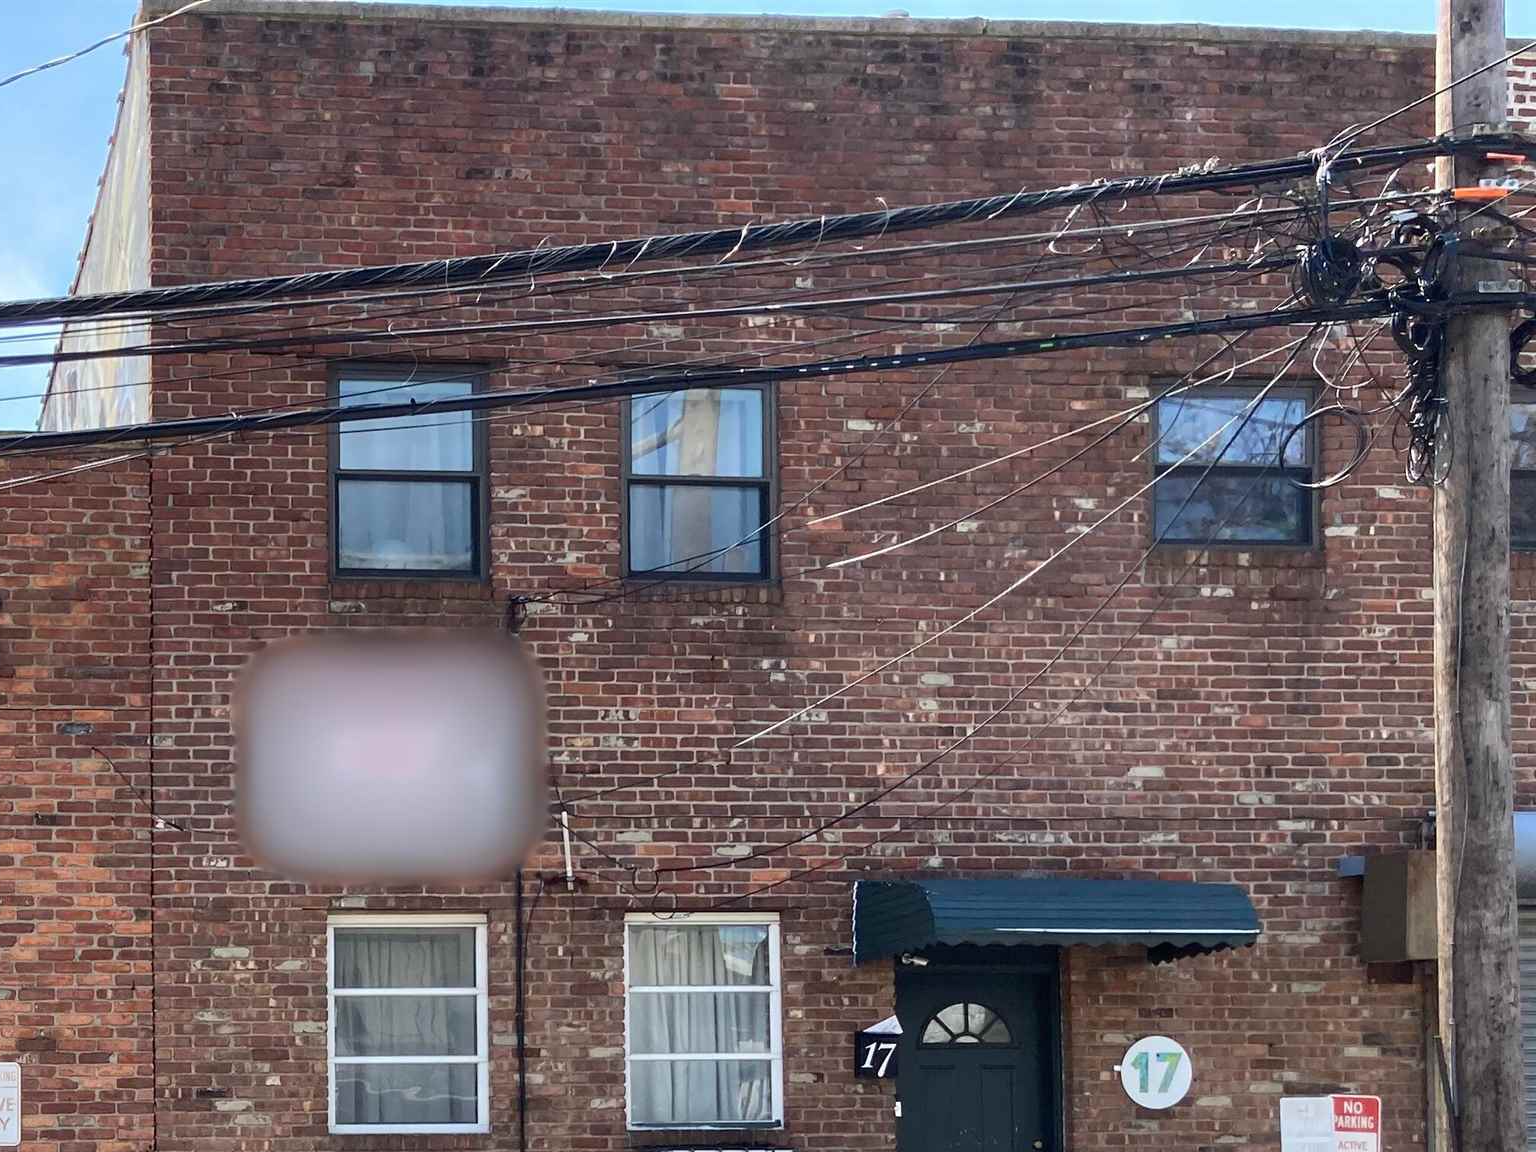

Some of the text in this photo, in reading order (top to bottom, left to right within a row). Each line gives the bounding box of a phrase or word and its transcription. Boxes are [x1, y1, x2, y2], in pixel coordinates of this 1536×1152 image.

[861, 1042, 897, 1078] 17
[1130, 1052, 1183, 1093] 17
[1343, 1101, 1364, 1114] NO
[1337, 1141, 1368, 1151] ACTIVE
